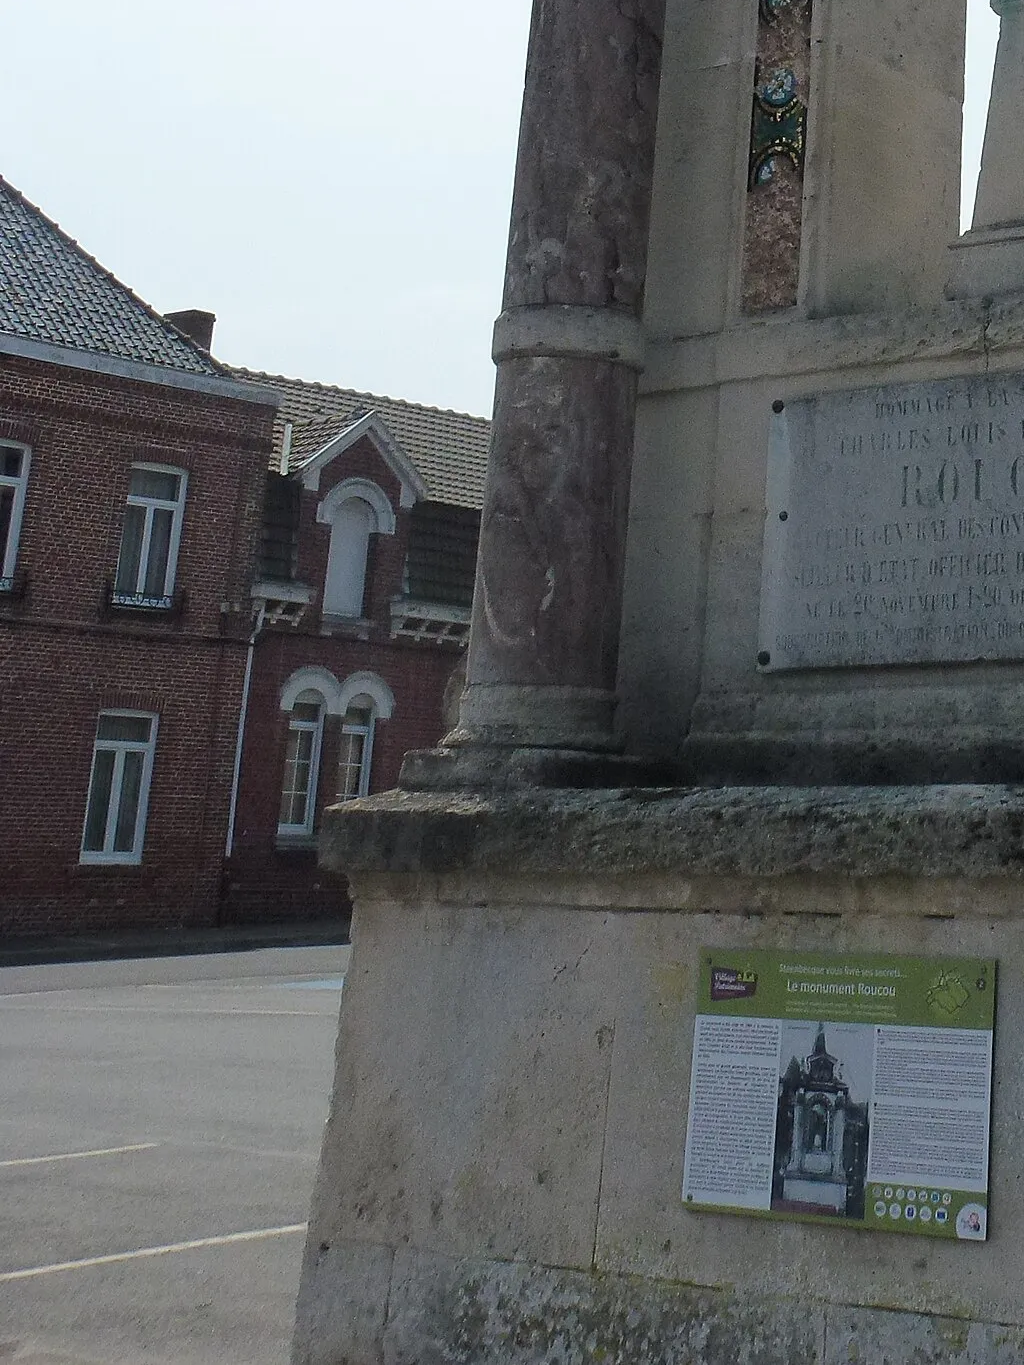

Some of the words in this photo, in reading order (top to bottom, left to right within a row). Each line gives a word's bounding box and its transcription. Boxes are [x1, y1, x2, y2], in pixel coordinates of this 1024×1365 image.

[840, 429, 931, 456] CHARLES
[787, 979, 798, 992] Le
[800, 981, 856, 995] monument
[858, 983, 897, 997] Roucou
